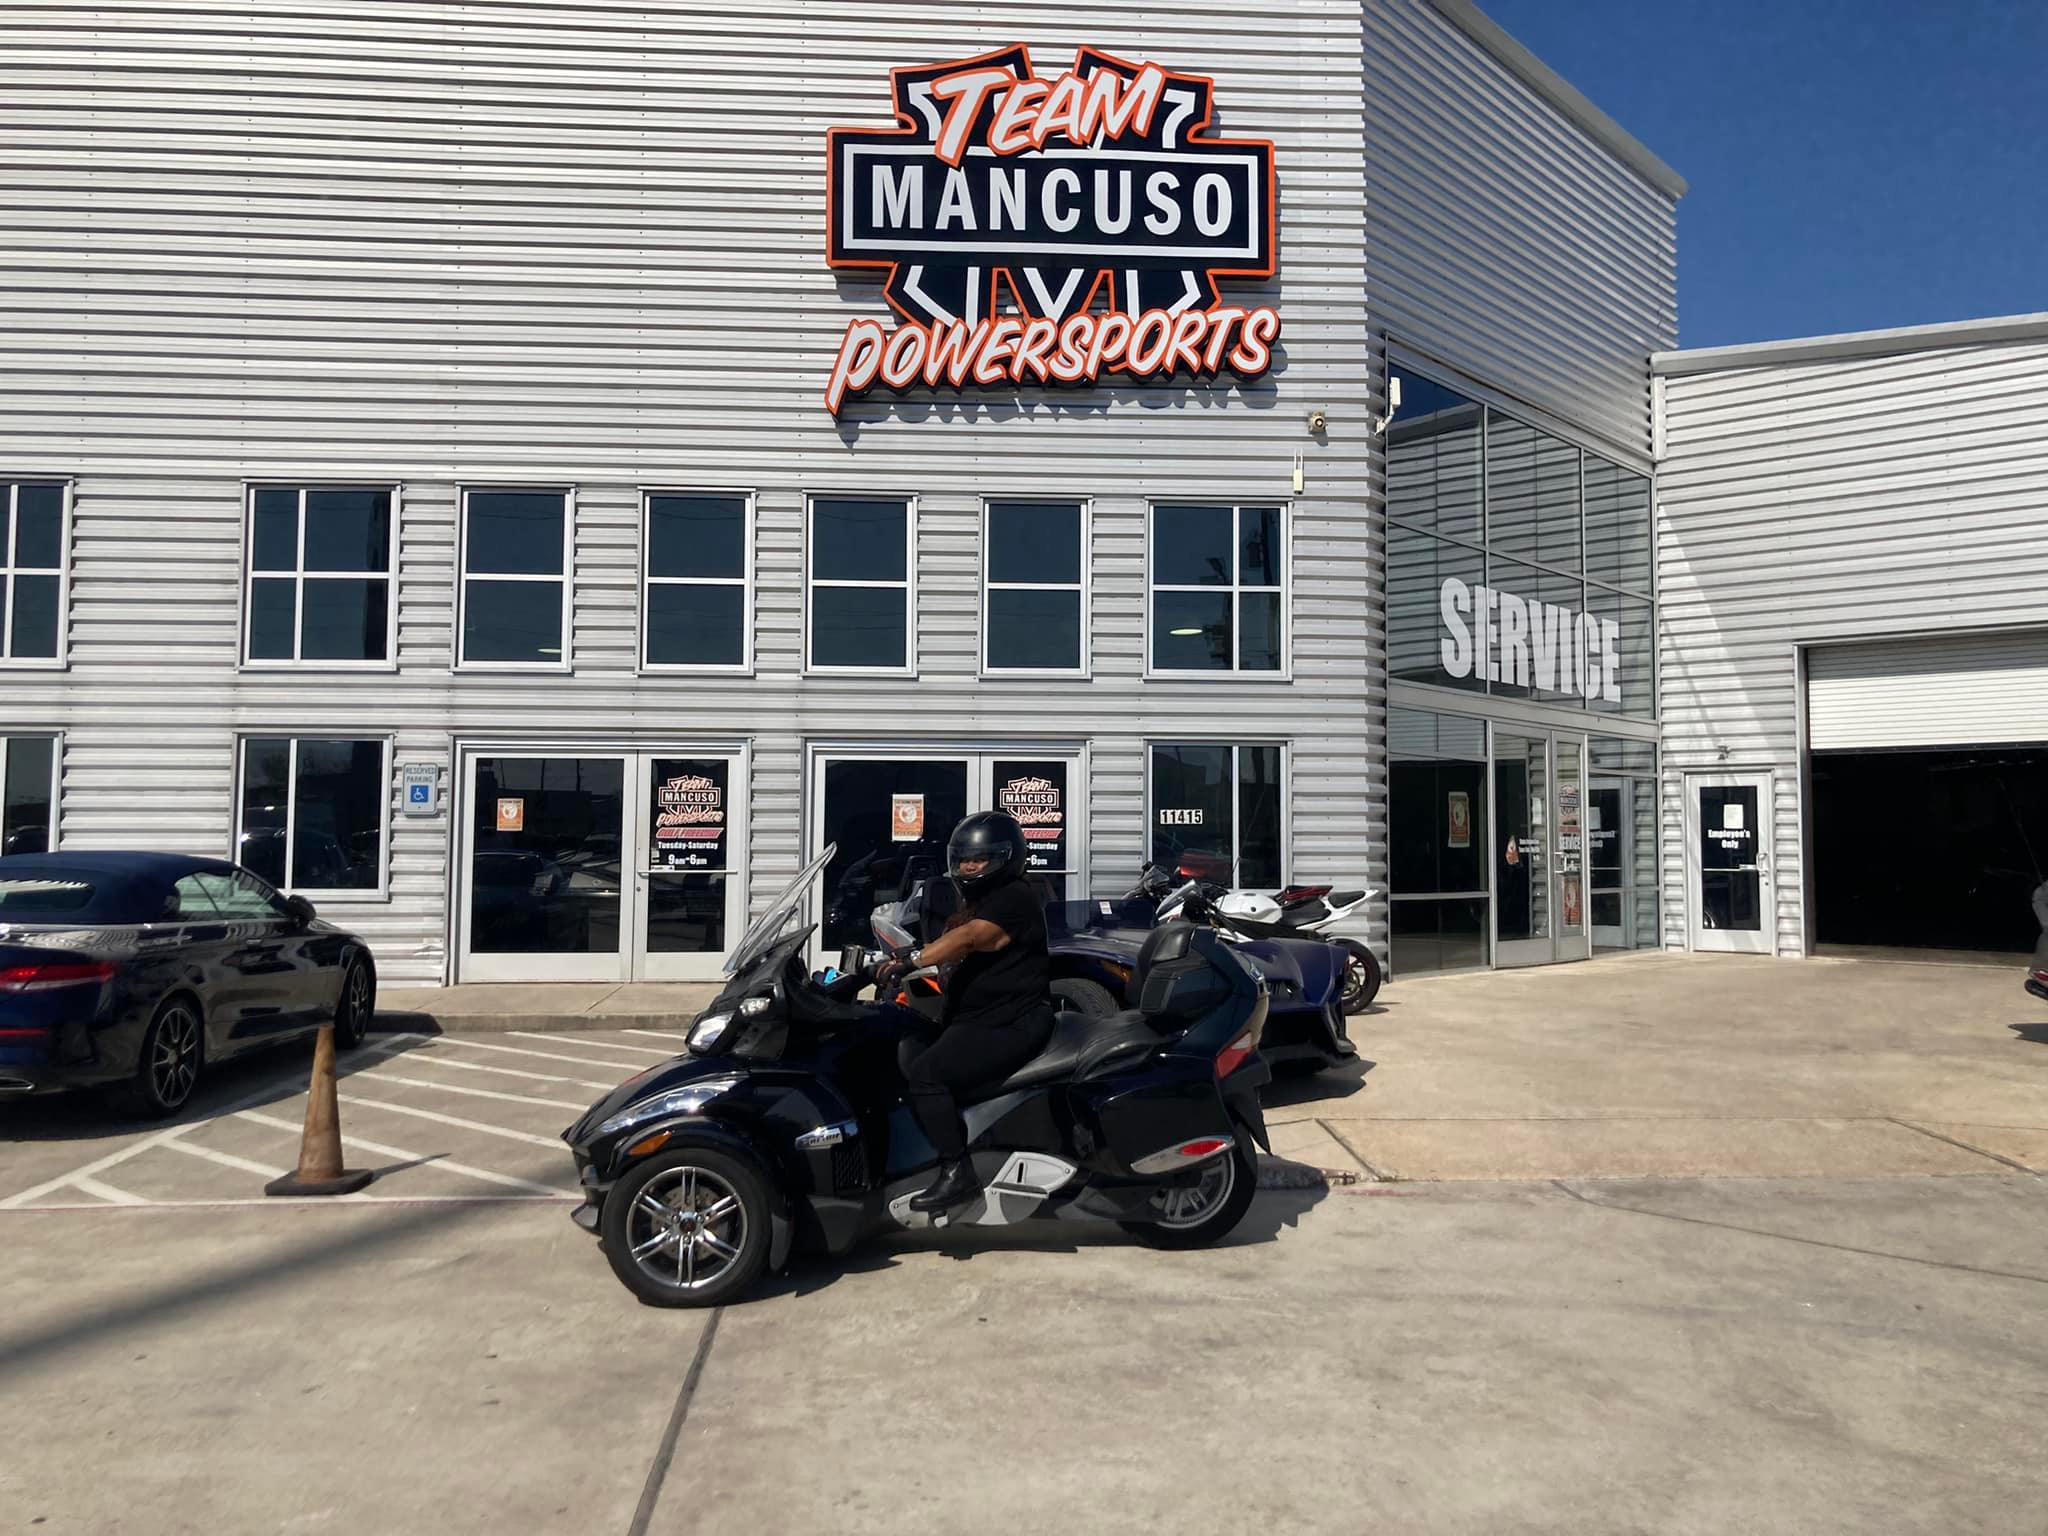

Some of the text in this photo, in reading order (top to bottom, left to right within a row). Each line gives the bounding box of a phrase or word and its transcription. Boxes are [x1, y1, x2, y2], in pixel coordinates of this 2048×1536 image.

[930, 61, 1165, 168] TEAM
[871, 165, 1233, 238] MANCUSO
[825, 306, 1281, 415] POWERSPORTS
[1440, 577, 1622, 703] SERVICE
[406, 767, 436, 775] RESERVED
[672, 778, 706, 791] TEAM
[1013, 779, 1046, 793] TEAM
[664, 792, 715, 802] MANCUSO
[1005, 794, 1054, 803] MANCUSO
[656, 811, 724, 828] POWERSPORTS
[1162, 810, 1202, 823] 11415
[658, 841, 719, 850] Tuesday-Saturday
[1721, 839, 1739, 849] Only
[668, 854, 707, 866] 9am-6pm
